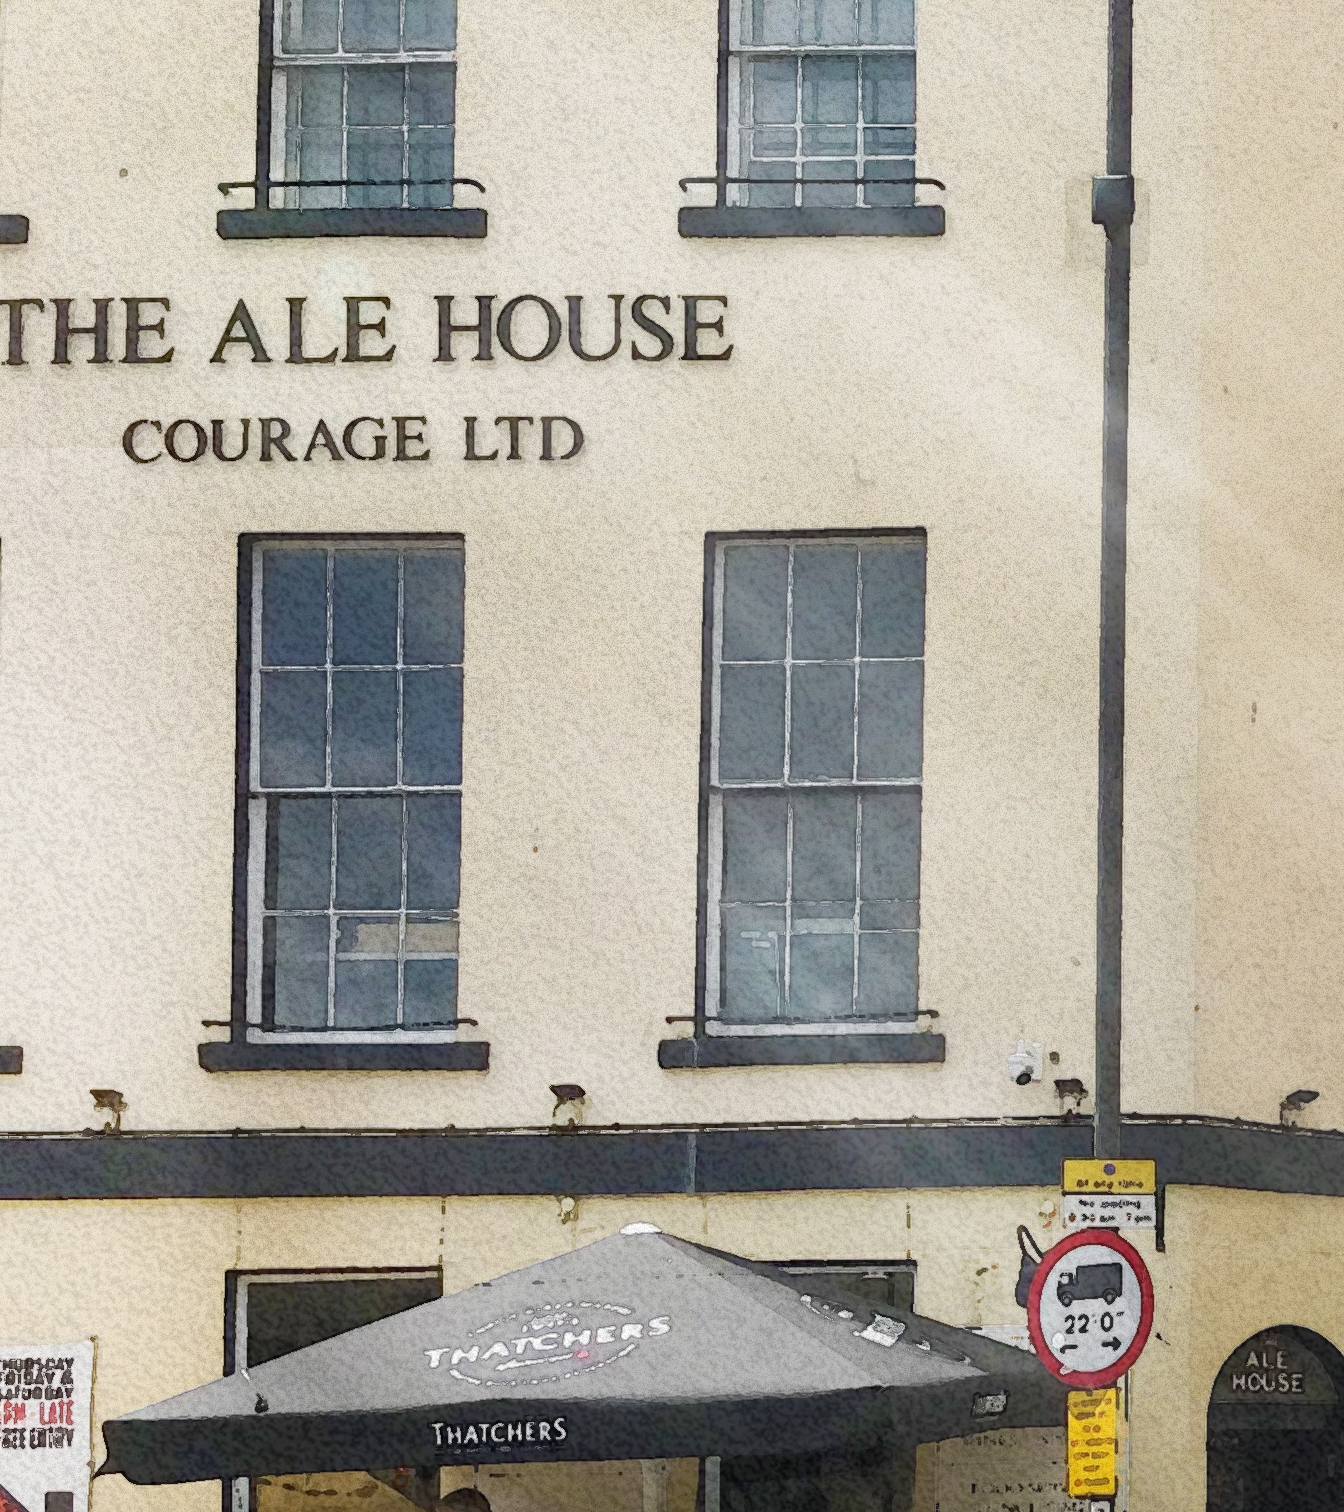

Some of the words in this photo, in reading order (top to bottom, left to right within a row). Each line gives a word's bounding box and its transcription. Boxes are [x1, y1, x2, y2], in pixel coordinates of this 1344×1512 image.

[0, 296, 175, 366] THE
[209, 295, 397, 365] ALE
[432, 293, 734, 363] HOUSE
[121, 416, 431, 463] COURAGE
[463, 415, 585, 461] LTD
[424, 1314, 671, 1369] THATCHERS
[1246, 1350, 1288, 1370] ALE
[1231, 1372, 1303, 1393] HOUSE
[431, 1417, 567, 1445] THATCHERS
